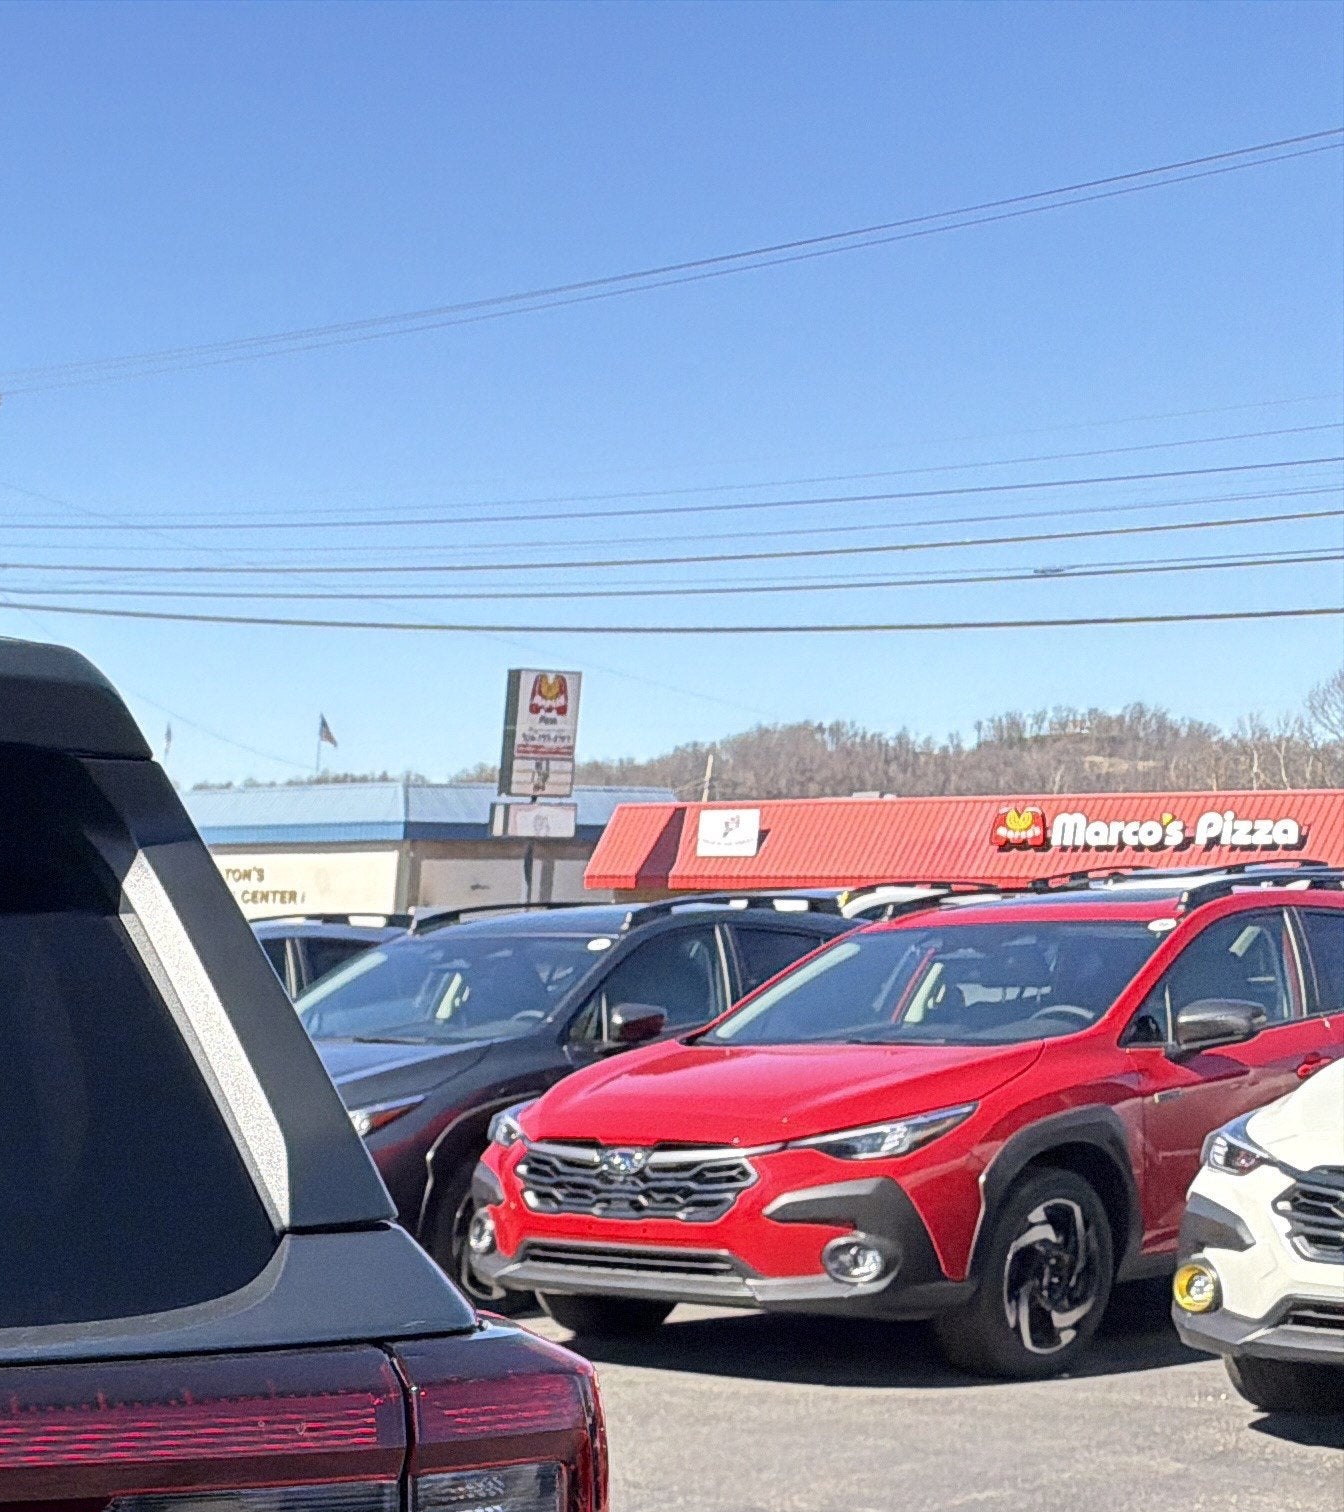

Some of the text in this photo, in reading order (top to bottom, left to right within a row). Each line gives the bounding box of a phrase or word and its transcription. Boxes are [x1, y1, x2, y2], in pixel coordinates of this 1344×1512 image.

[1051, 810, 1299, 846] Marco's Pizza
[240, 890, 298, 905] CENTER
